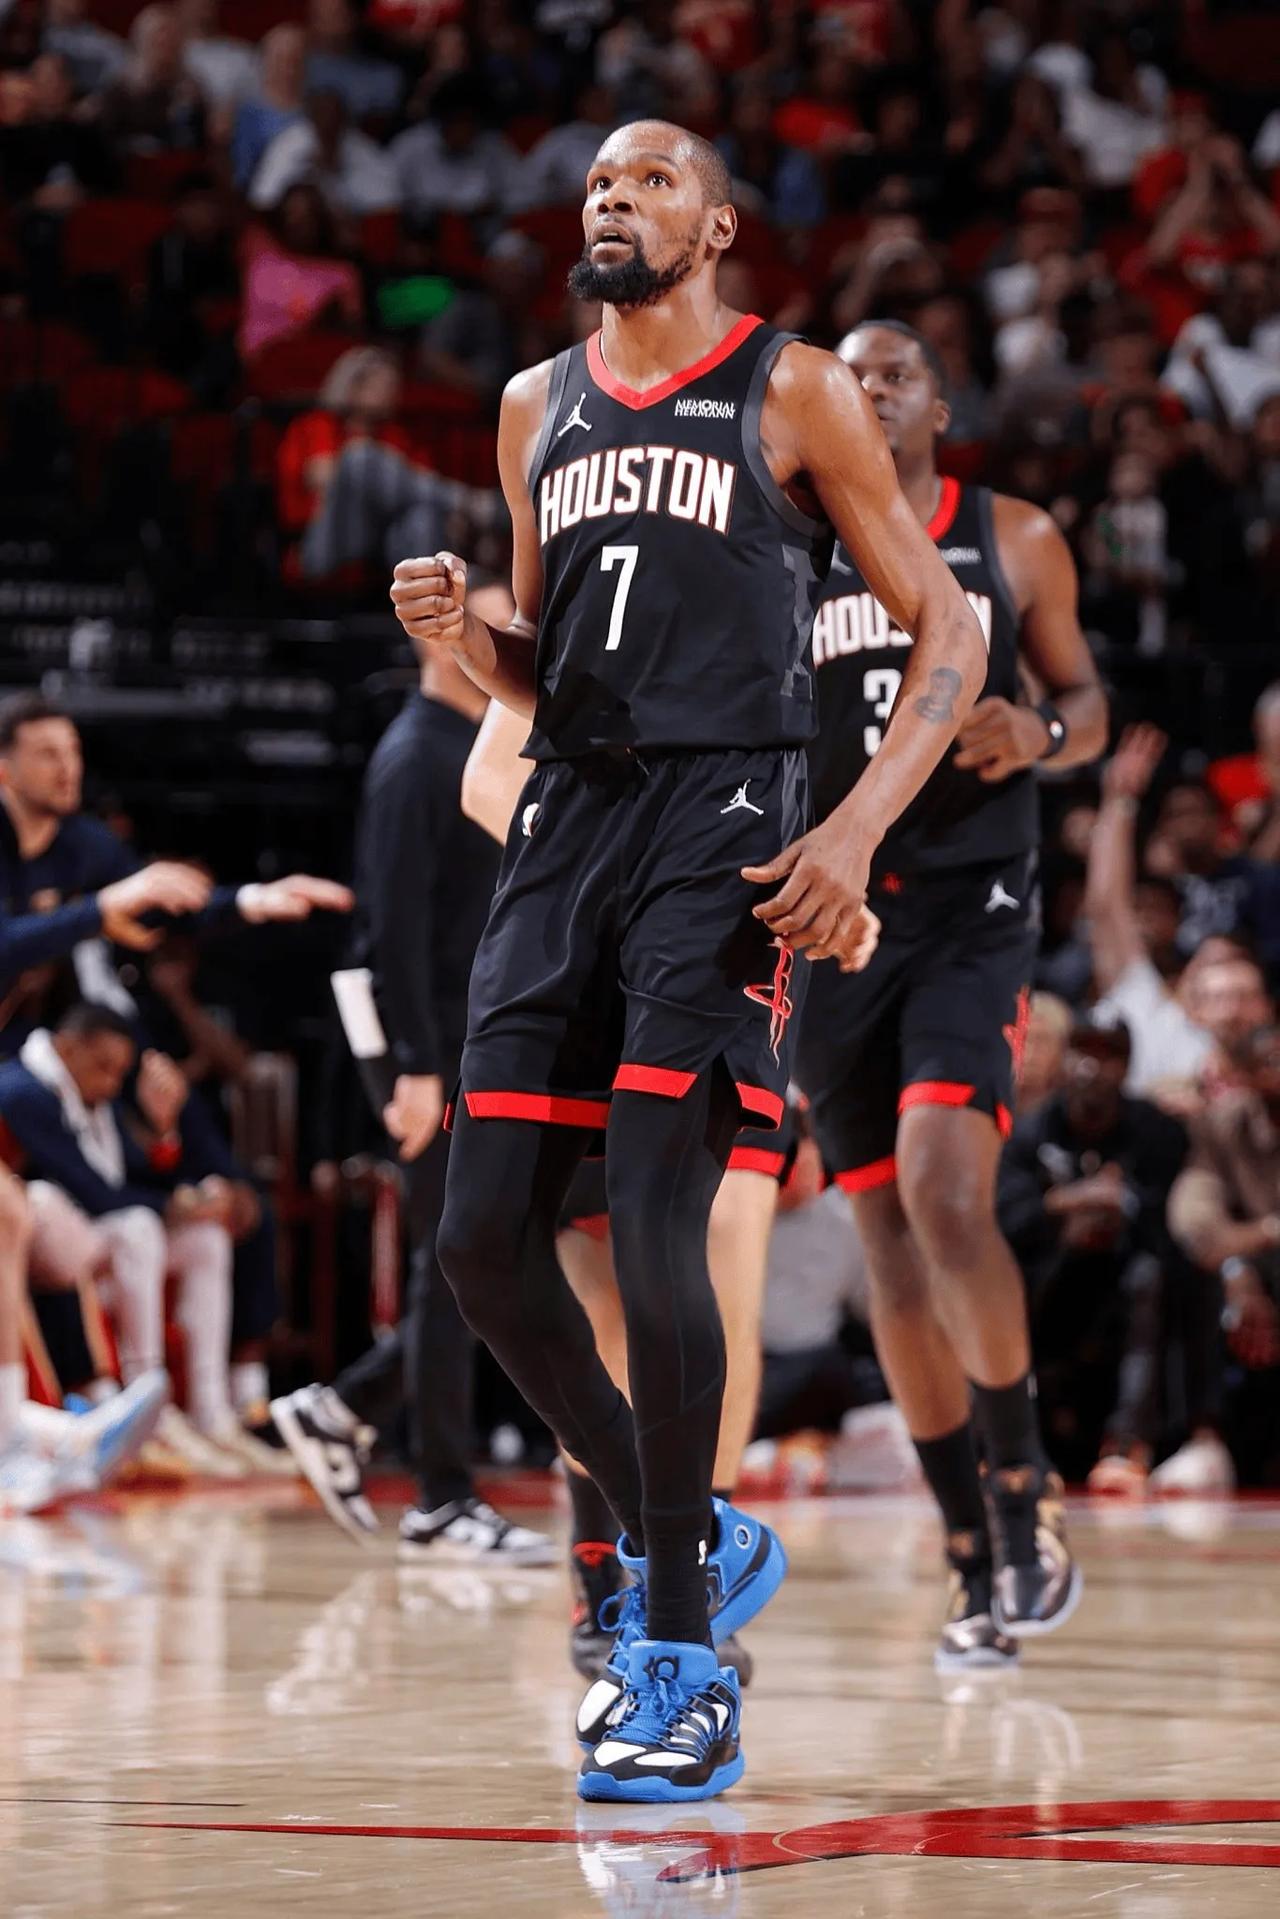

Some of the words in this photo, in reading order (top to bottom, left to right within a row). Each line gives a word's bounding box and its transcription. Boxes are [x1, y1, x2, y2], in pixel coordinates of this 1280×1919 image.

[674, 407, 735, 419] HERMANN
[675, 398, 735, 412] MEMORIAL
[540, 444, 738, 547] HOUSTON
[600, 545, 640, 651] 7
[812, 591, 993, 671] HOUN
